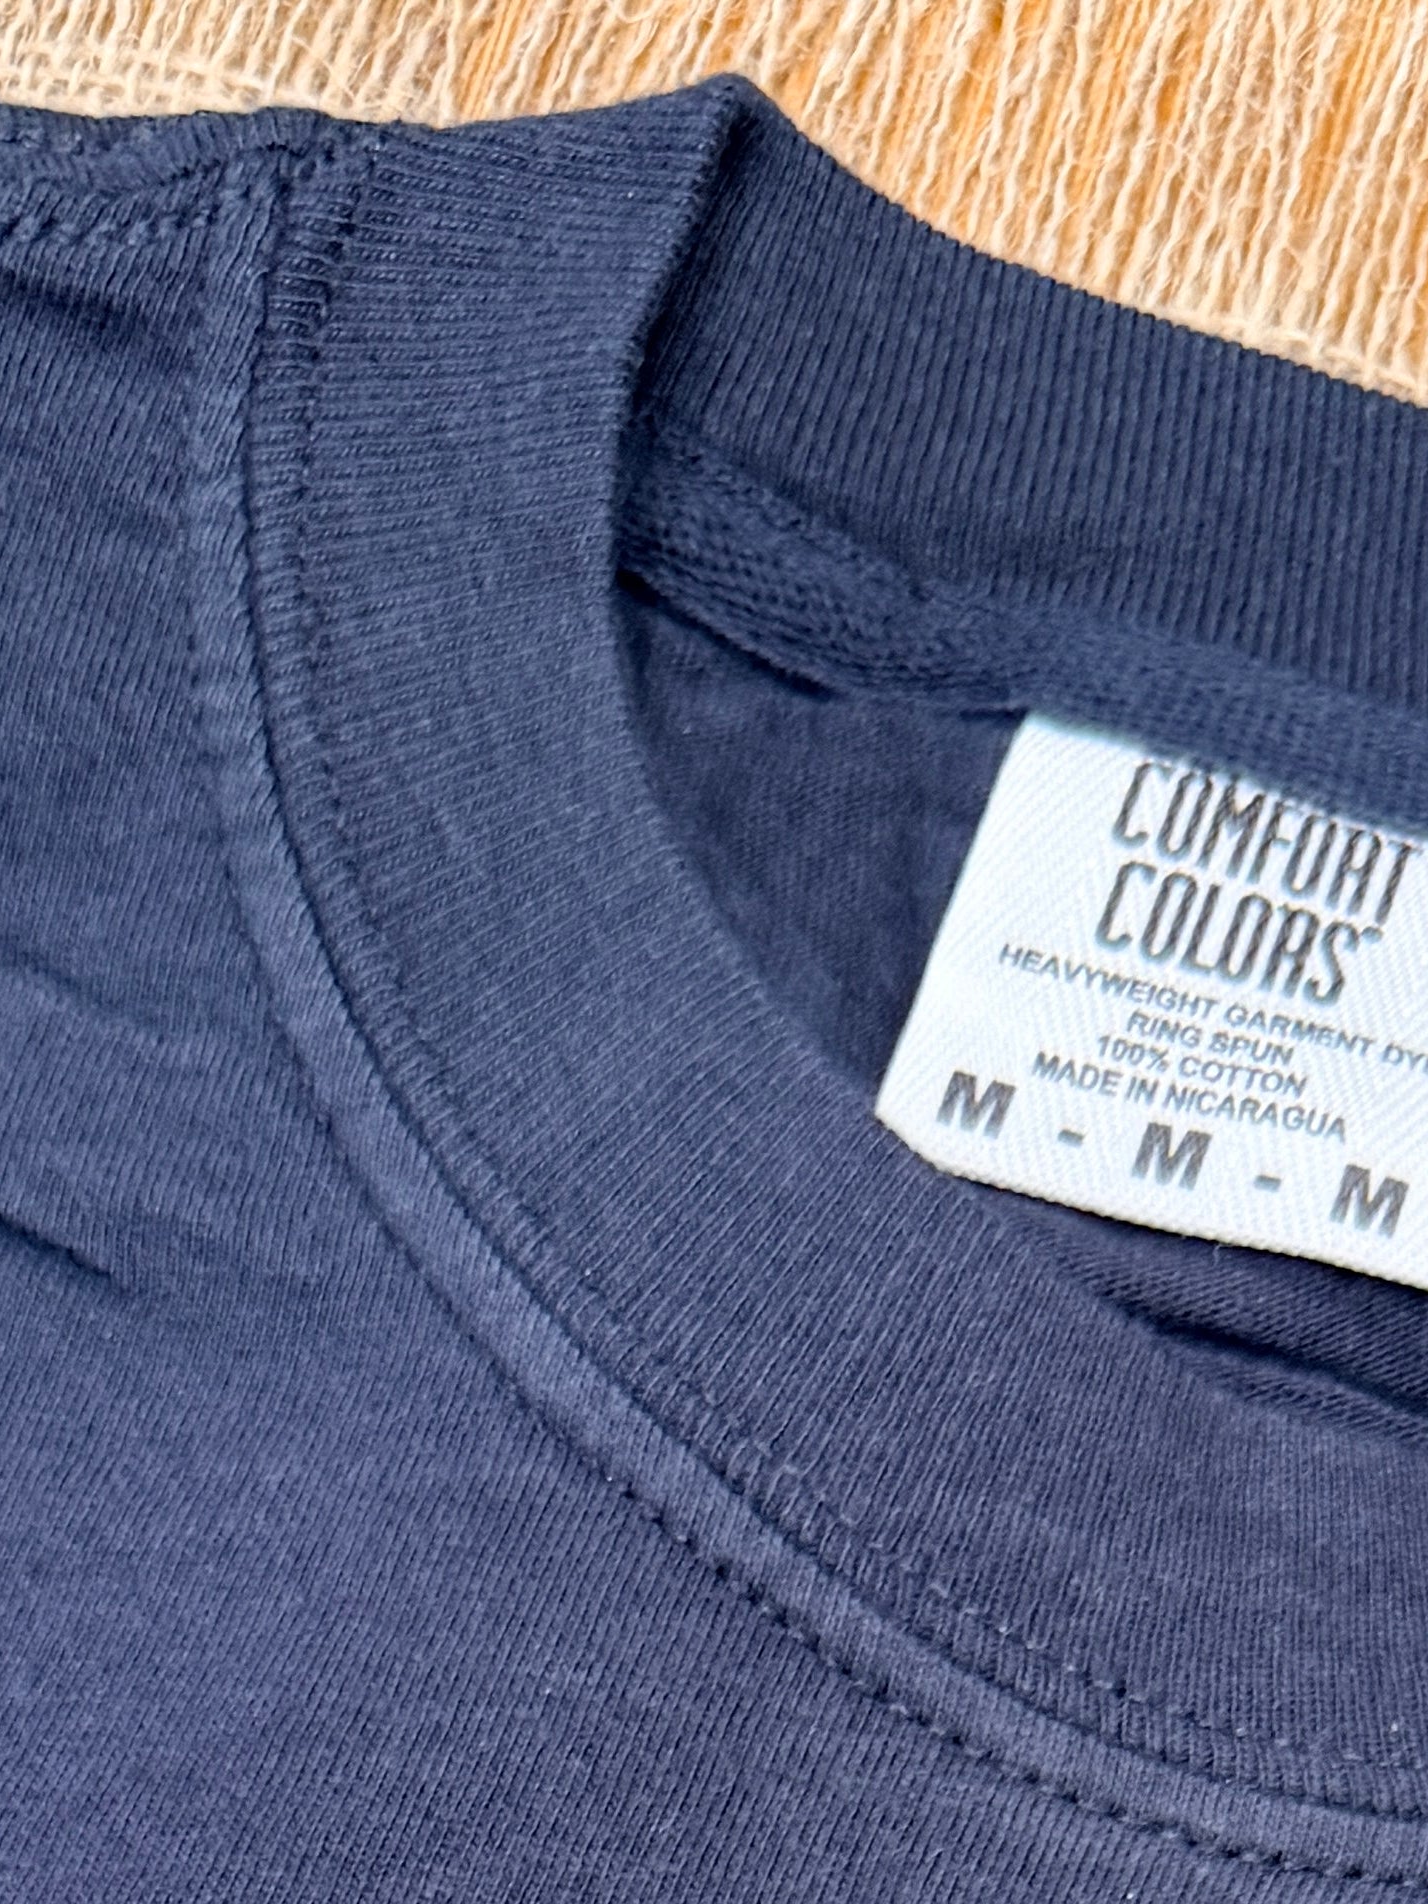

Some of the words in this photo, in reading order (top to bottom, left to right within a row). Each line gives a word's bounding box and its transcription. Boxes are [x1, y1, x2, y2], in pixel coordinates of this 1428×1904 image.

[1112, 762, 1422, 924] COMFORT
[998, 942, 1220, 1020] HEAVYWEIGHT
[1224, 1002, 1375, 1057] GARMENT
[1126, 1010, 1203, 1048] RING
[1209, 1031, 1295, 1066] SPUN
[1031, 1051, 1124, 1096] MADE
[1125, 1076, 1159, 1105] IN
[1162, 1084, 1347, 1143] NICARAGUA
[1097, 1035, 1170, 1073] 100%
[1179, 1055, 1307, 1098] COTTON
[935, 1070, 1016, 1140] M
[1131, 1121, 1213, 1191] M
[1329, 1163, 1410, 1239] M
